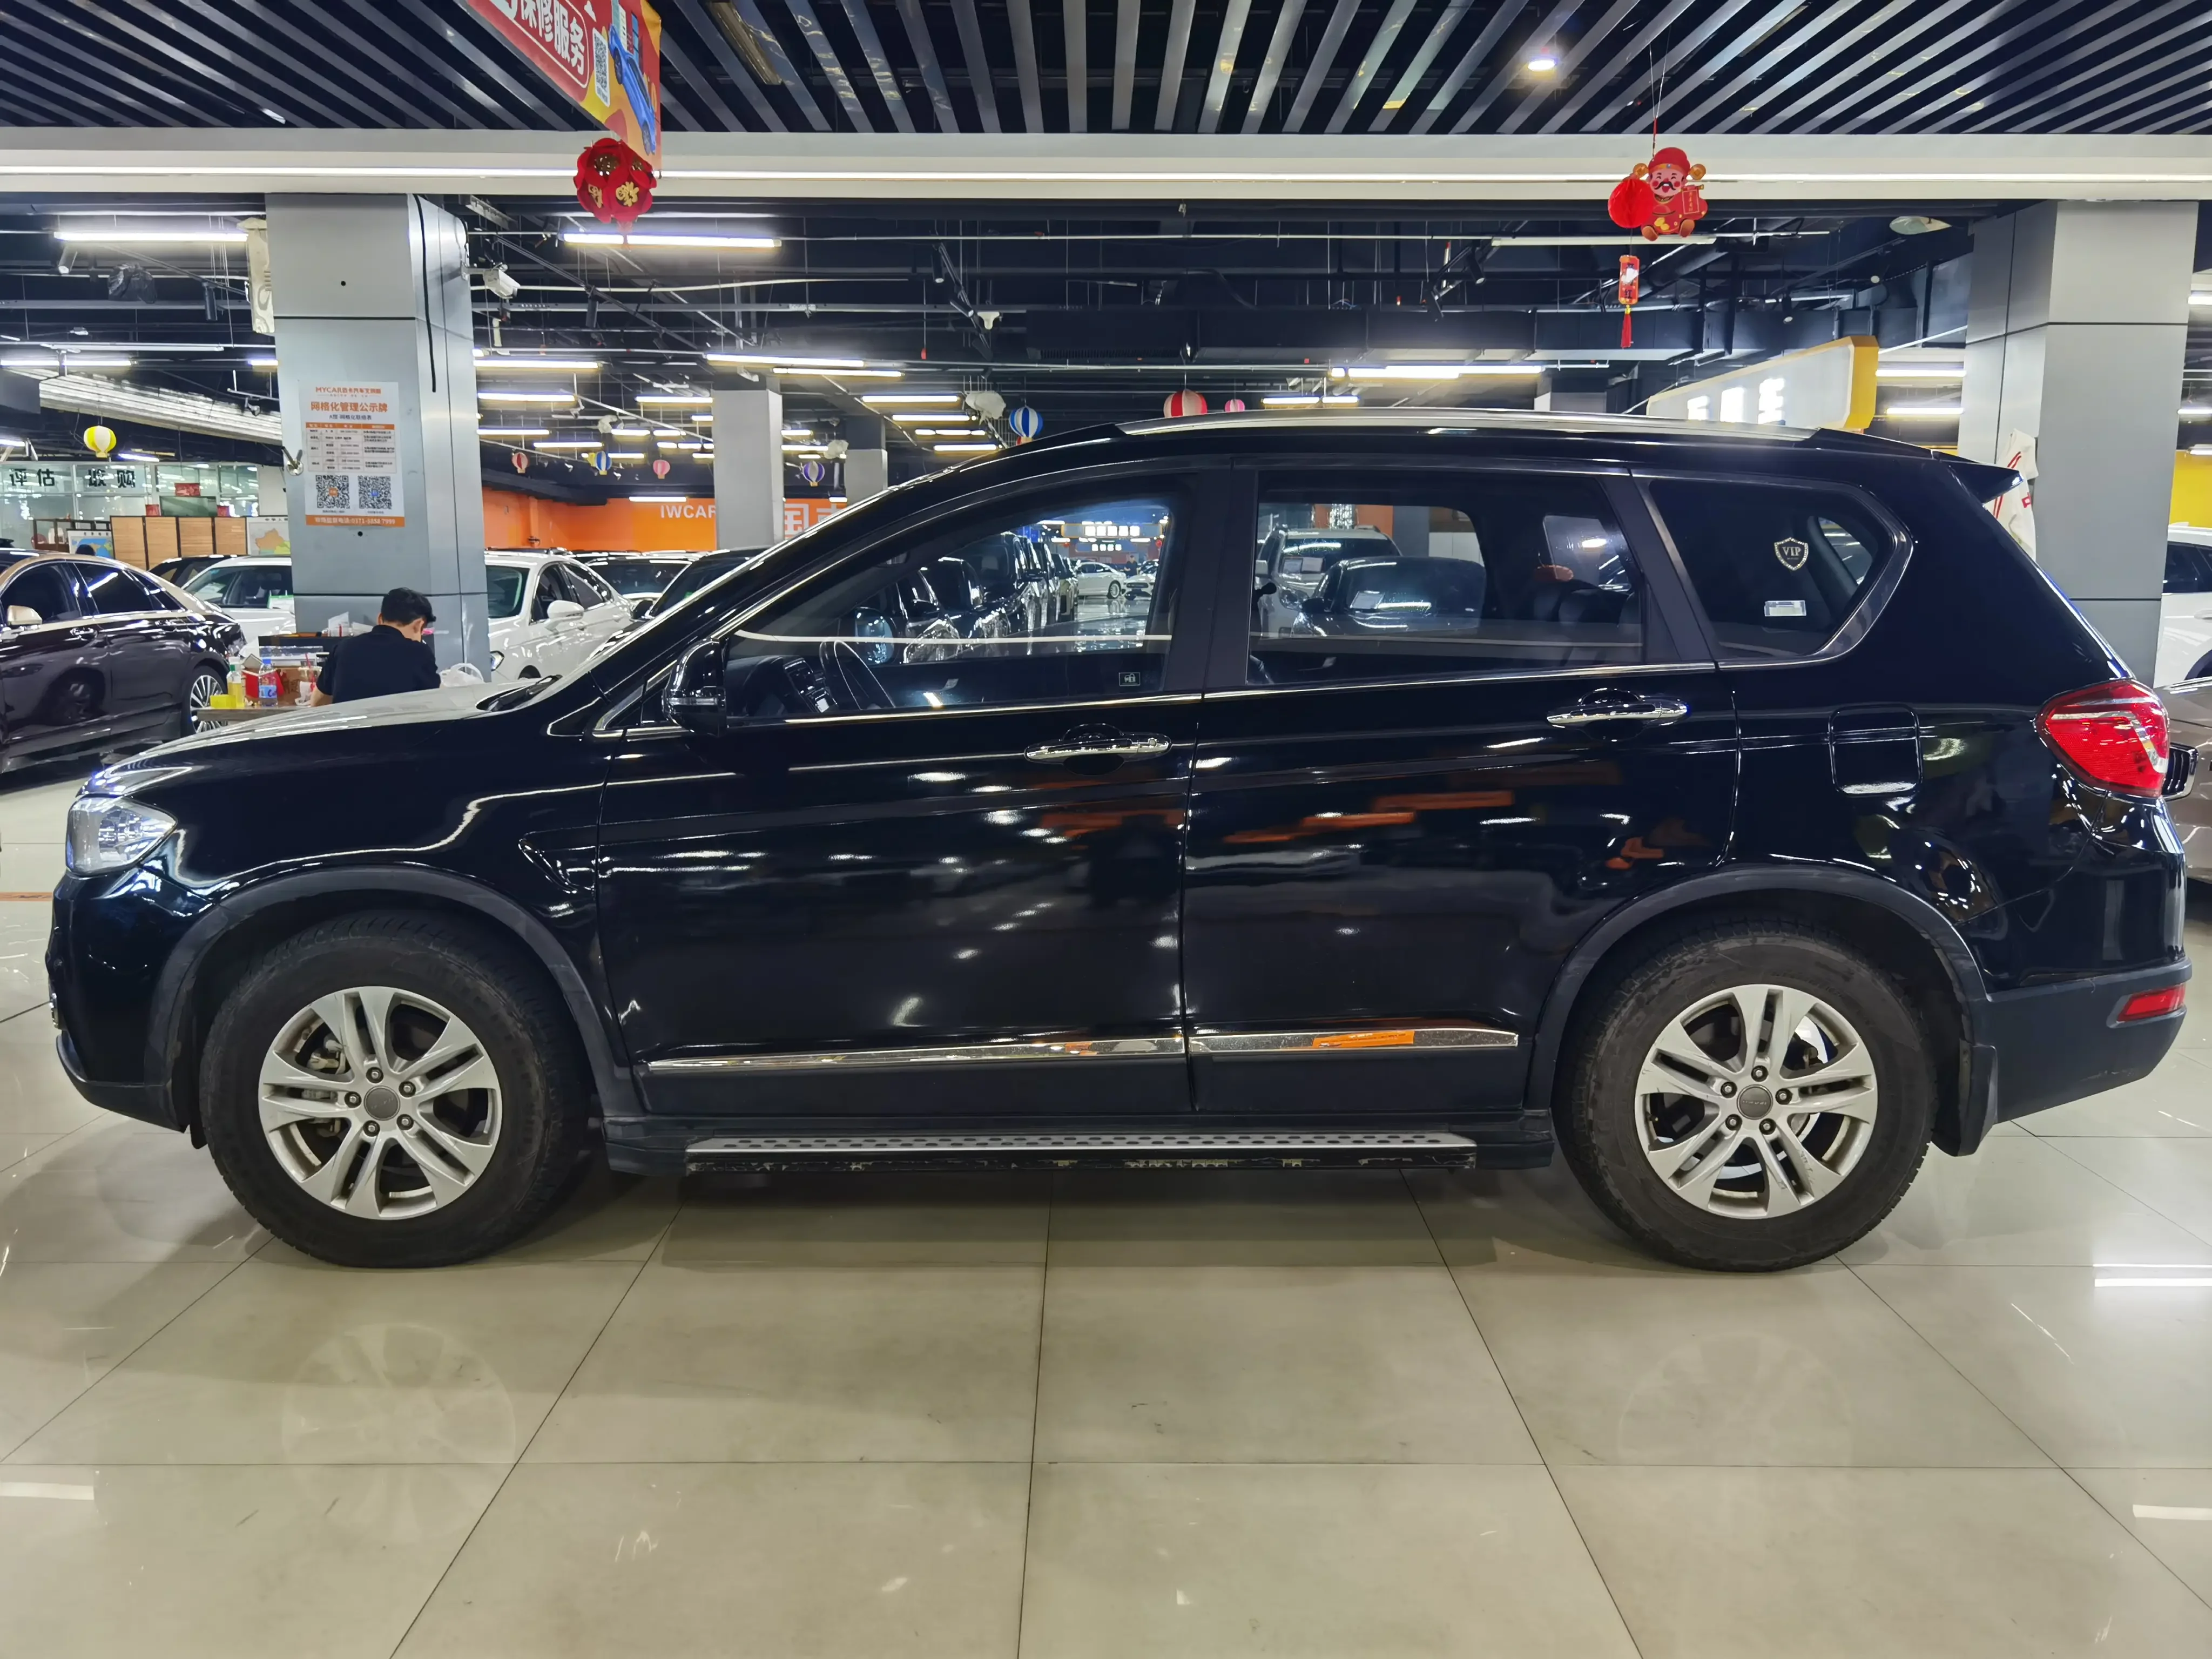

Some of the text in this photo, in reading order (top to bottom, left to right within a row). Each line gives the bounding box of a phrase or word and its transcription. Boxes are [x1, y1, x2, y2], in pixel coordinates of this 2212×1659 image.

[311, 401, 388, 413] 网格化管理公示牌
[9, 469, 136, 488] 评估 收购
[1782, 547, 1802, 556] VIP
